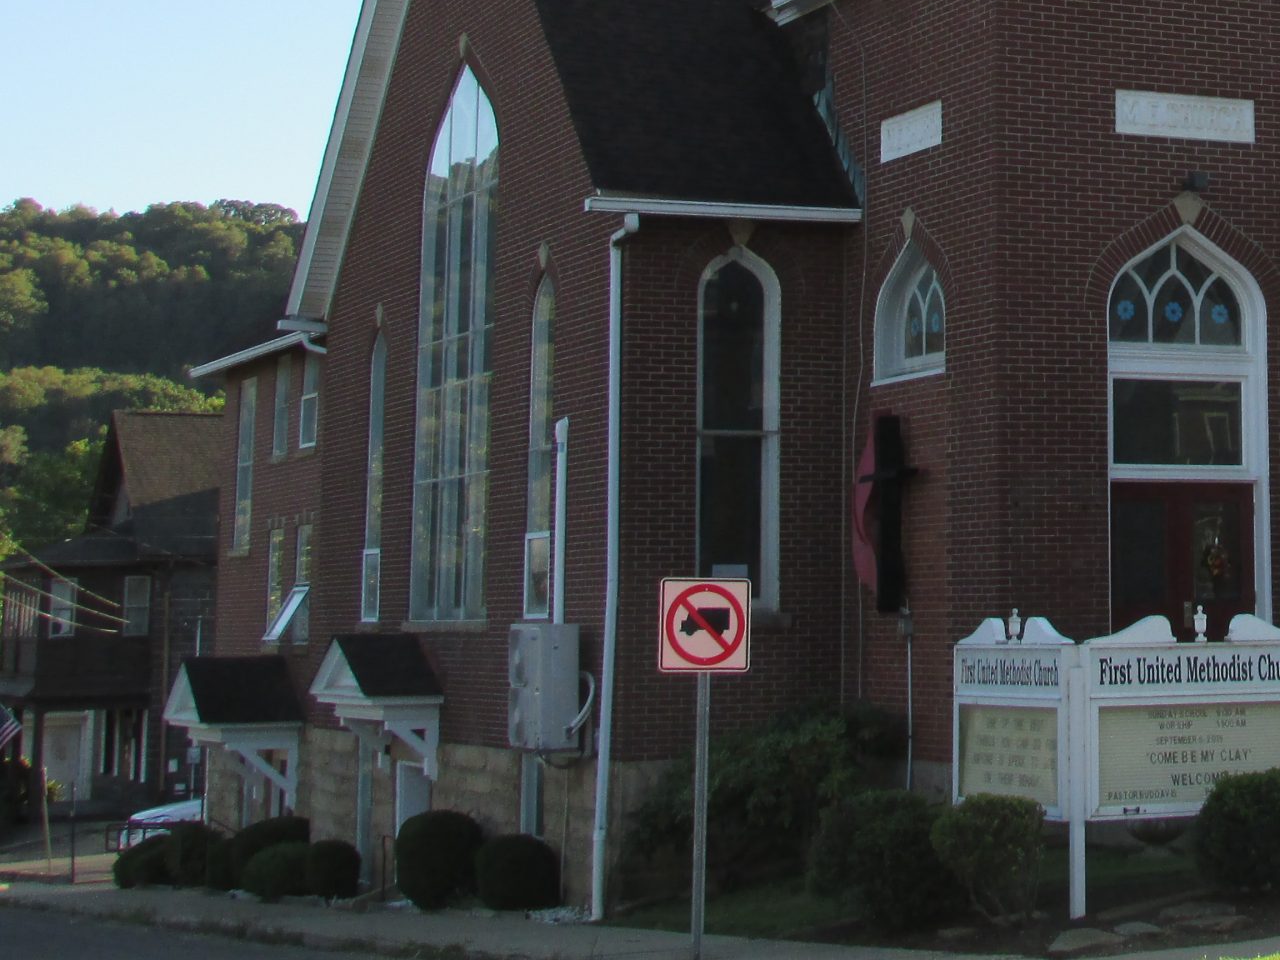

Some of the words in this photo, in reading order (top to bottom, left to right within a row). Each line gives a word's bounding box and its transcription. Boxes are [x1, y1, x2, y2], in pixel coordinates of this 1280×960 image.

[961, 658, 976, 685] First
[977, 658, 998, 685] United
[1000, 658, 1032, 686] Methodist
[1034, 658, 1058, 687] Church
[1099, 657, 1132, 685] First
[1136, 656, 1182, 684] United
[1186, 654, 1254, 683] Methodist
[1156, 735, 1197, 745] SEPTEMBER
[1181, 750, 1197, 764] BE
[1200, 749, 1215, 762] MY
